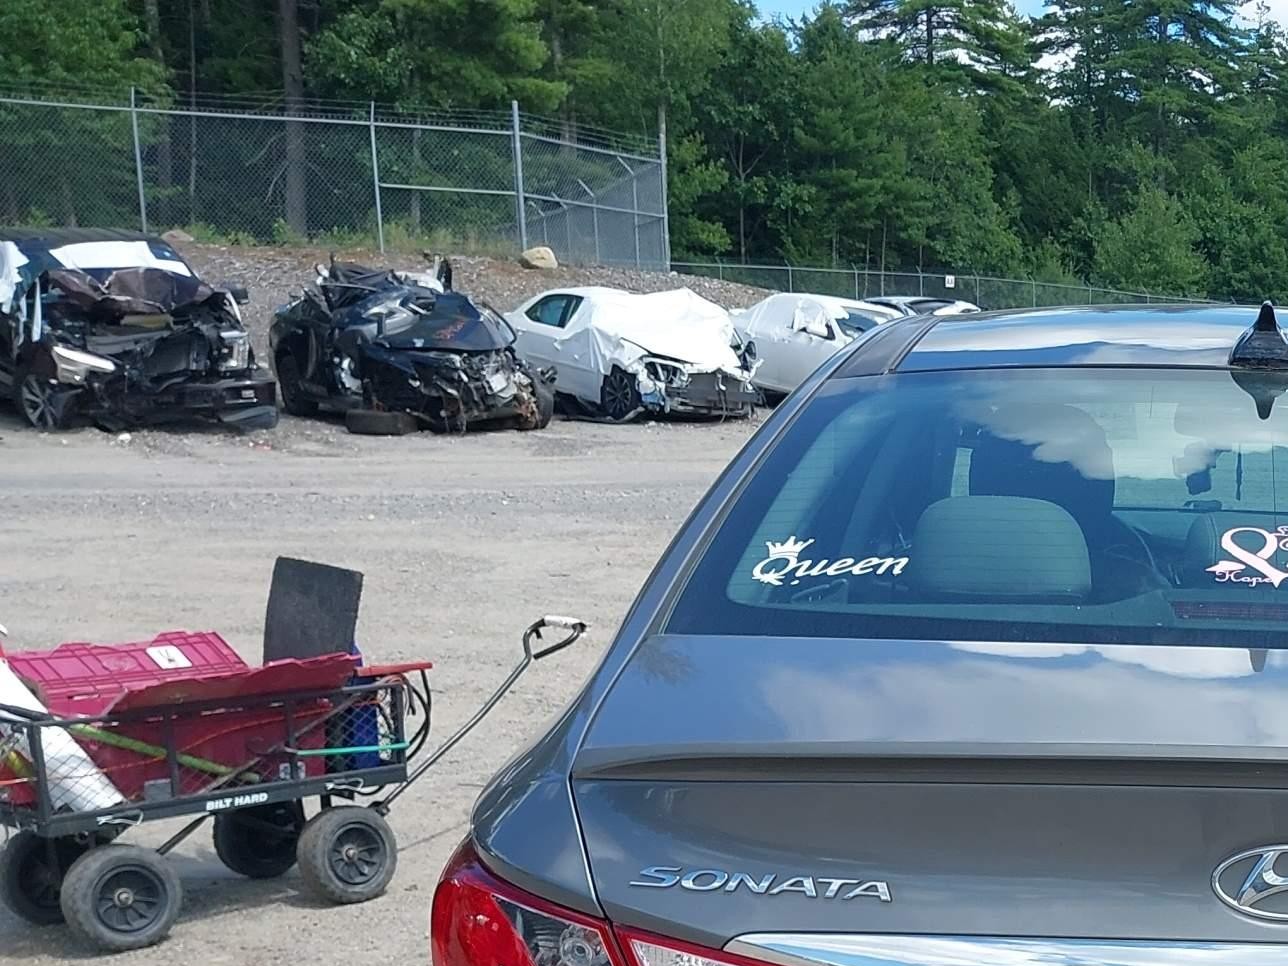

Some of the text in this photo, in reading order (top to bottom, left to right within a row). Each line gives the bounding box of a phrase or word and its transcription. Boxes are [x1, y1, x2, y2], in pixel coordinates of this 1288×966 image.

[751, 554, 910, 586] Queen
[206, 792, 269, 811] BILT HARD
[629, 866, 893, 902] SONATA
